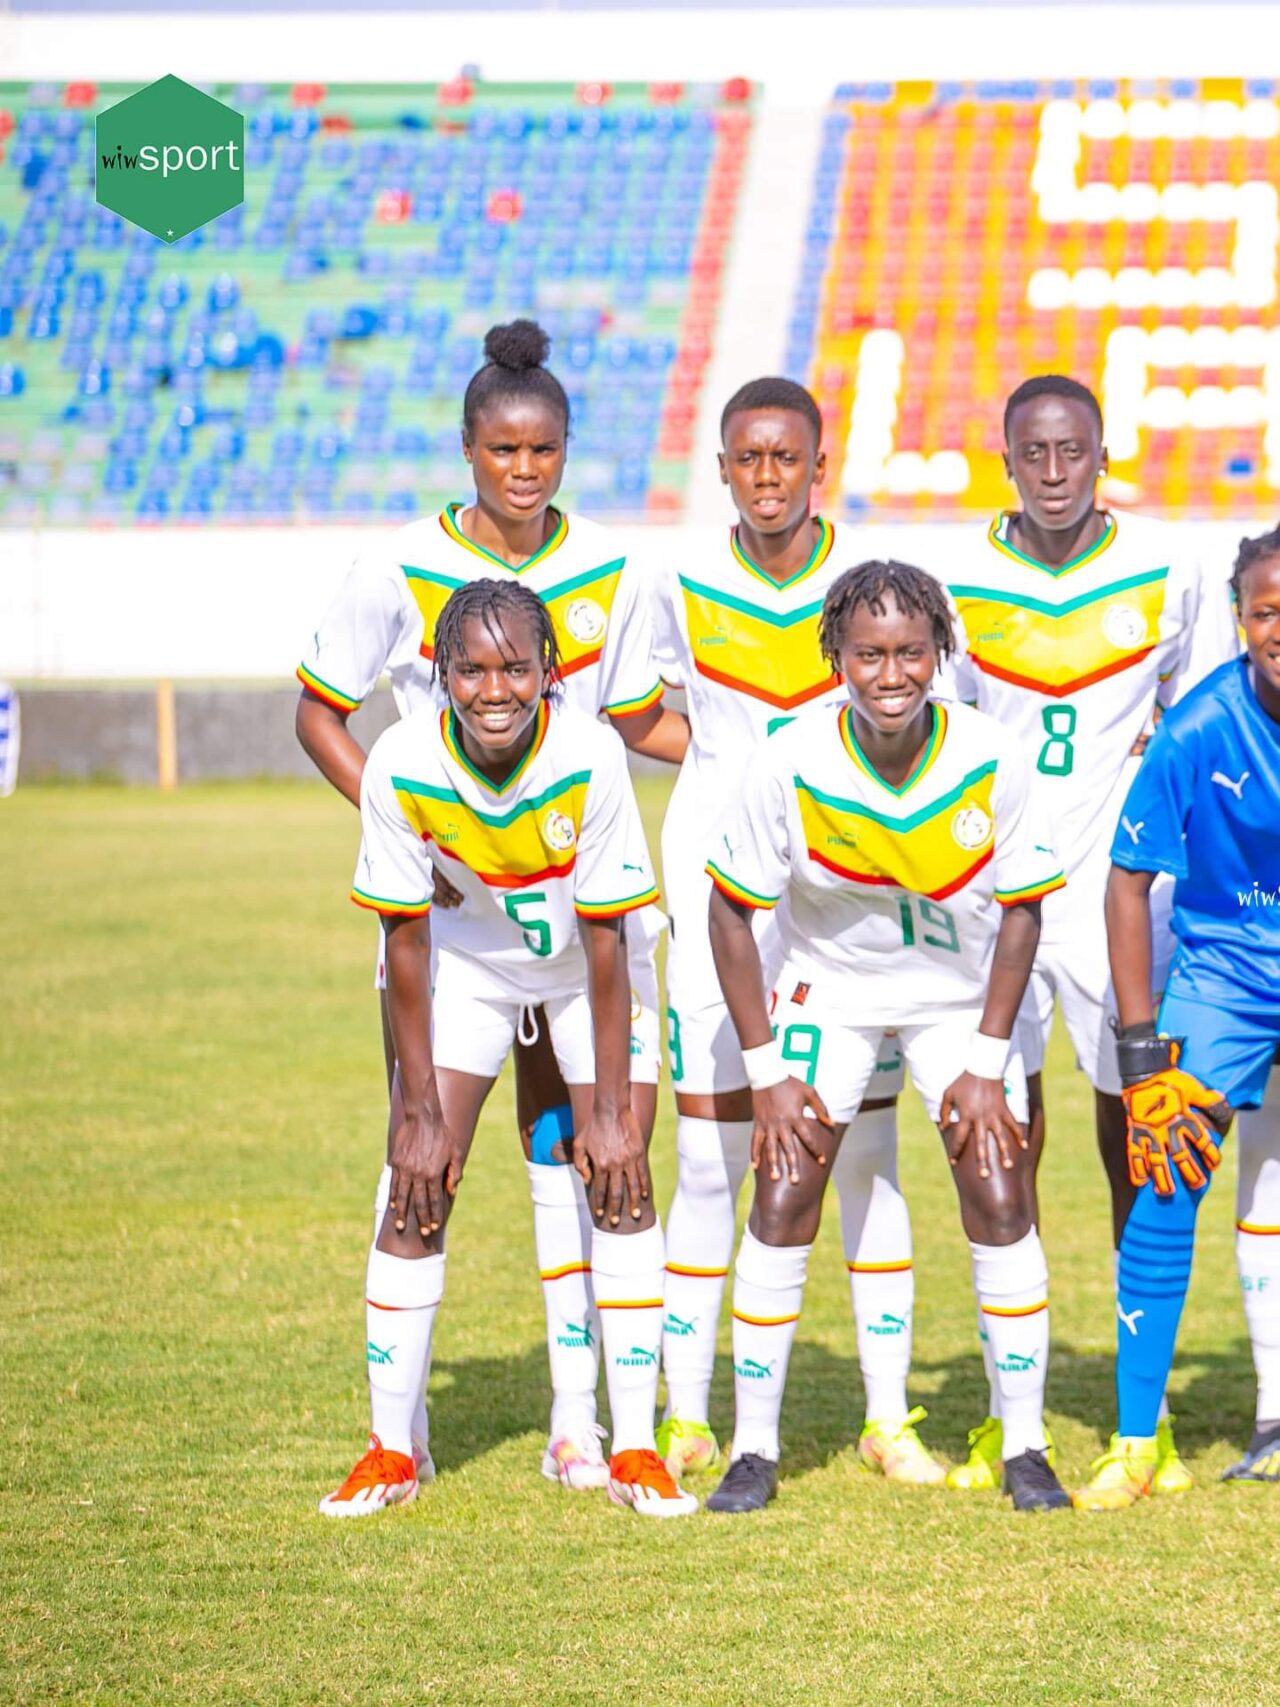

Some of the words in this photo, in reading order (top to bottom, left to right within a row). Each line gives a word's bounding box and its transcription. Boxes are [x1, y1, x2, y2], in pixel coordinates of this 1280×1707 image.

[1036, 703, 1077, 778] 8
[503, 890, 554, 958] 5
[895, 895, 961, 953] 19
